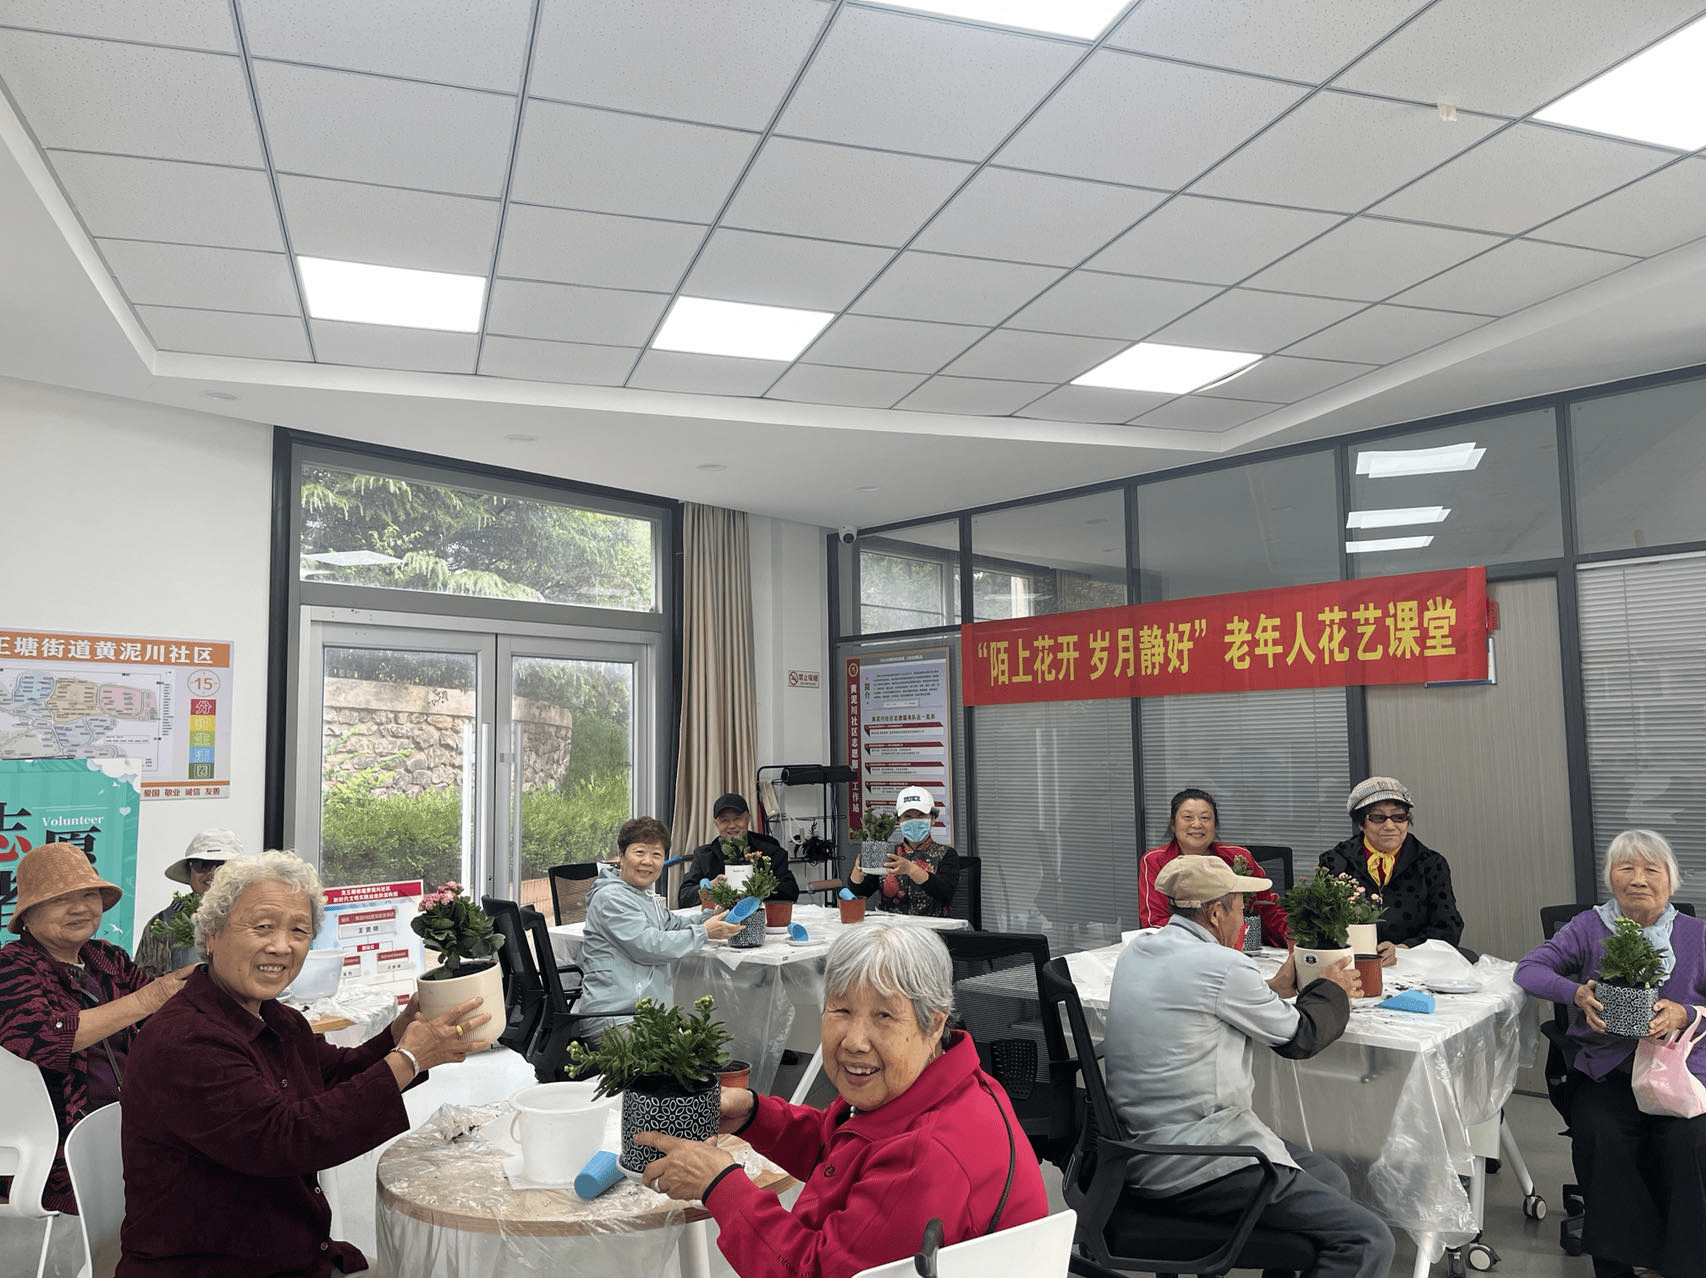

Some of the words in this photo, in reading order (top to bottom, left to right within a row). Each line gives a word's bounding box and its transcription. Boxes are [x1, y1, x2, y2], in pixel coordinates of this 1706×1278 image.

[978, 635, 1080, 686] “陌上花开
[1089, 618, 1207, 681] 岁月静好”
[1223, 596, 1457, 671] 老年人花艺课堂
[193, 677, 213, 690] 15
[850, 684, 861, 813] 黄泥川社区志愿服工作站
[42, 815, 104, 826] Volunteer
